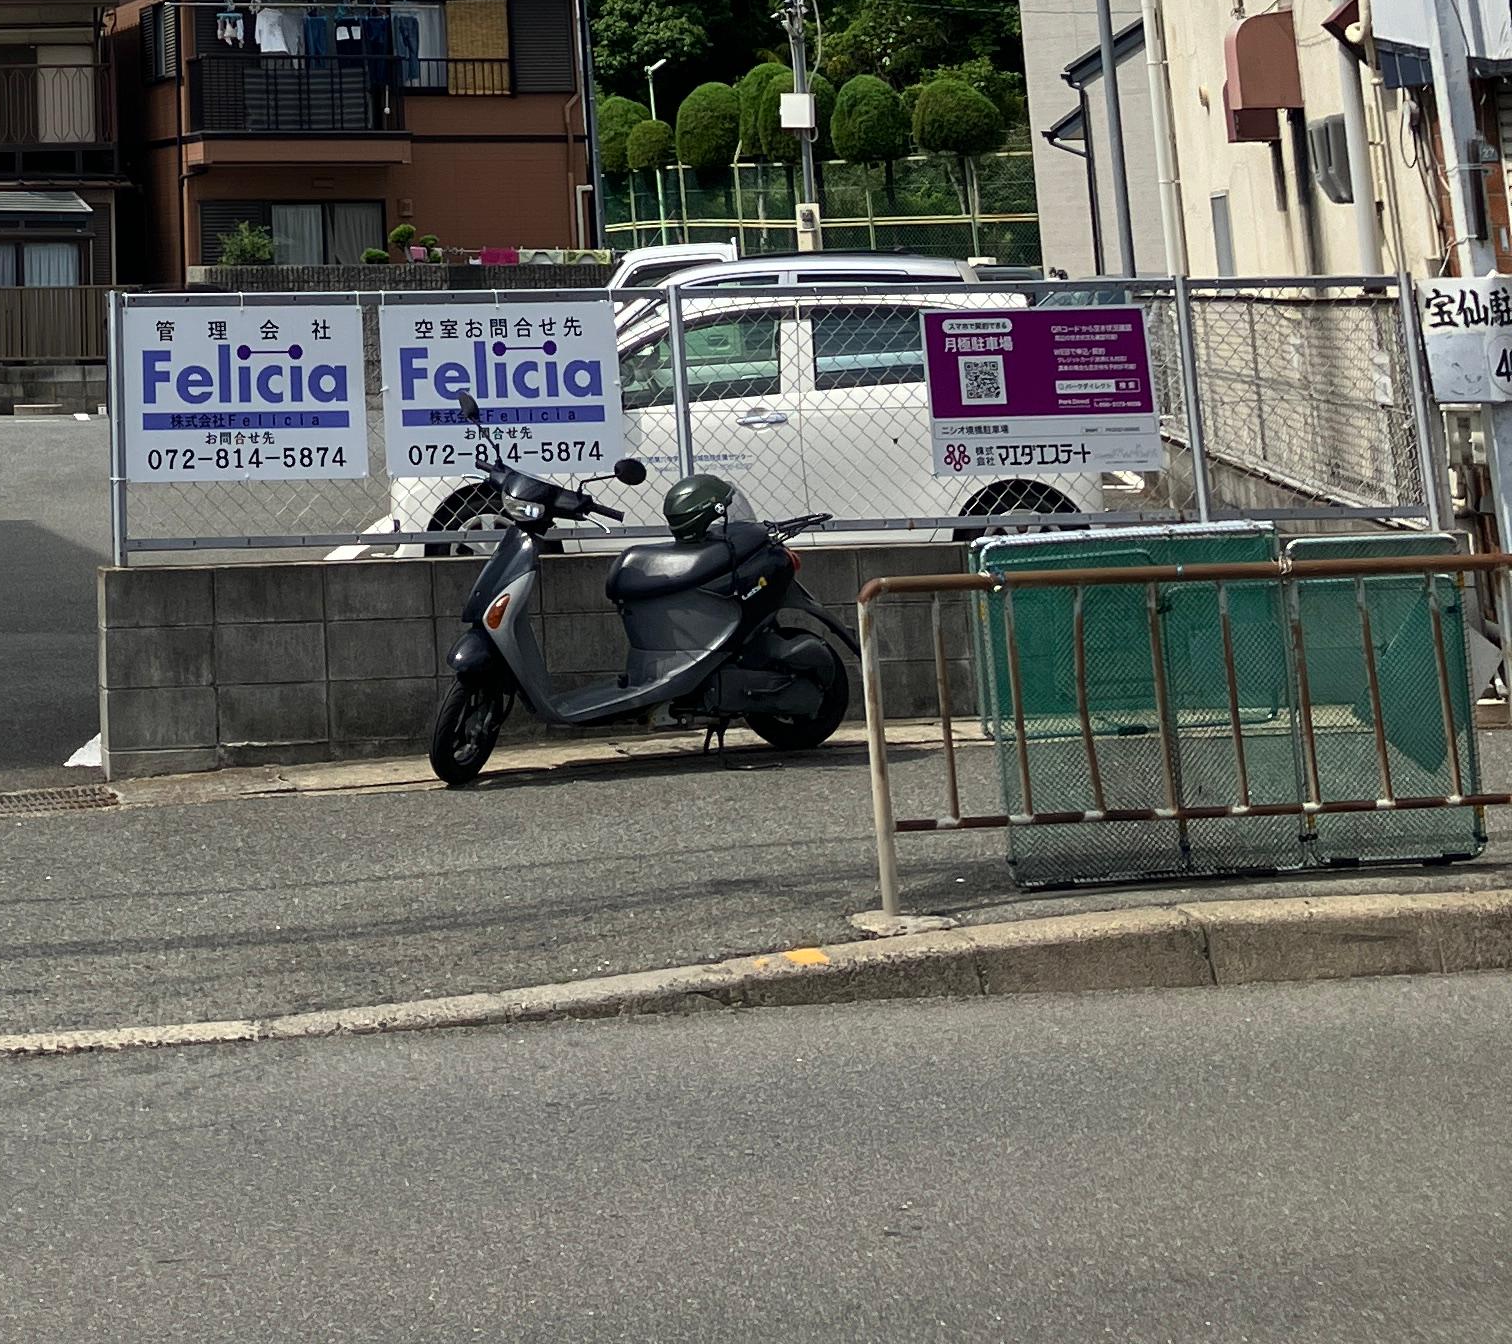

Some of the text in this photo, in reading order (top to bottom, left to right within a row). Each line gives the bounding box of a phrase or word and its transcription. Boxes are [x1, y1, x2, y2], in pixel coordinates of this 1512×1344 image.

[155, 319, 331, 342] 管理会社
[414, 316, 583, 340] 空室お問合せ先
[944, 336, 1014, 353] 月極駐車場
[142, 344, 349, 405] Felicia
[399, 340, 604, 401] Felicia
[1496, 348, 1512, 382] 4
[204, 431, 276, 446] お問合せ先
[463, 426, 533, 441] お問合せ先
[147, 446, 348, 471] 072-814-5874
[408, 440, 604, 466] 072-814-5874
[996, 443, 1091, 466] マエダエステート
